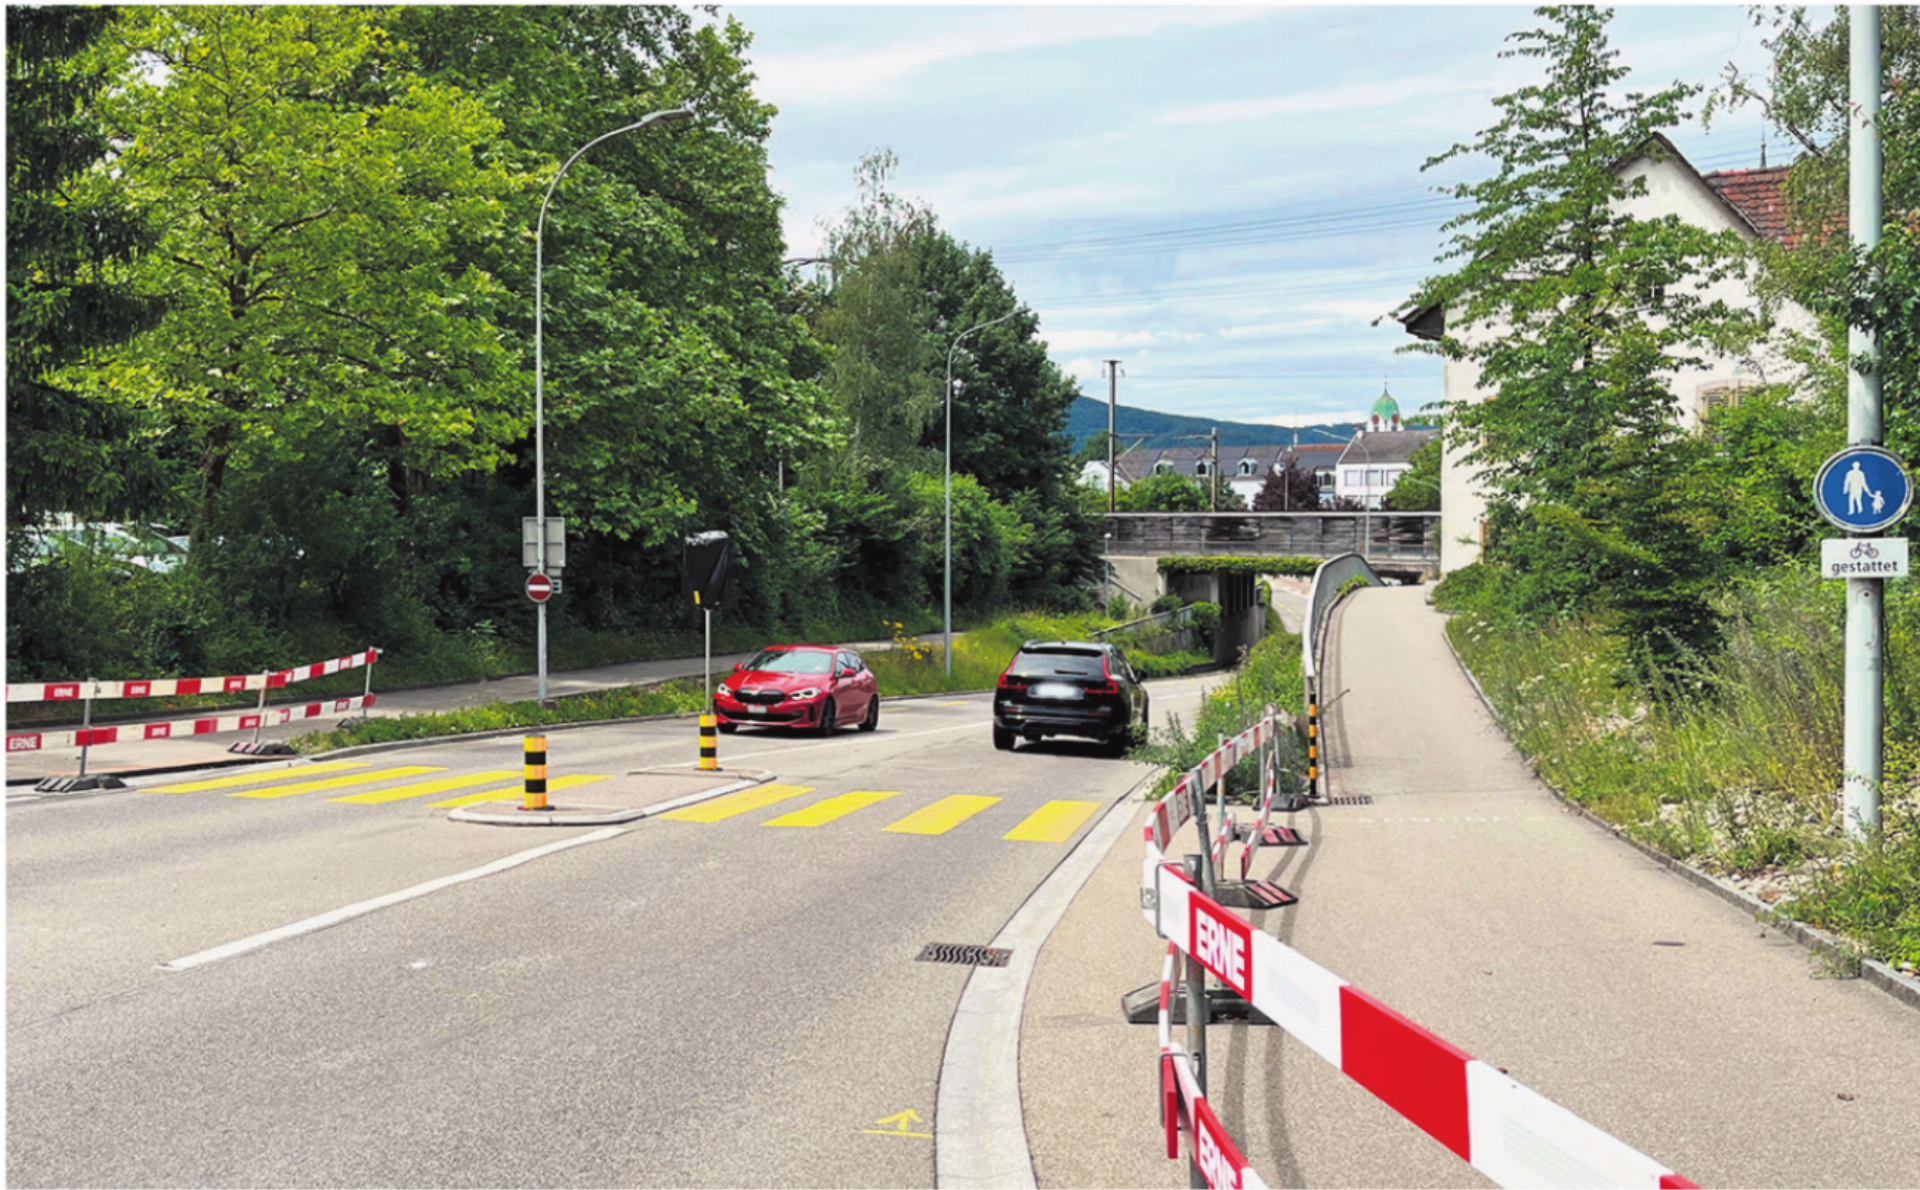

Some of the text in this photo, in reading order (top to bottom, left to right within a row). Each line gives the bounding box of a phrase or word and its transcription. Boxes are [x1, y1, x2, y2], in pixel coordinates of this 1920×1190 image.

[1832, 561, 1898, 576] gestattet
[54, 687, 74, 697] ERNE
[9, 736, 38, 750] ERNE
[1196, 907, 1246, 992] ERNE
